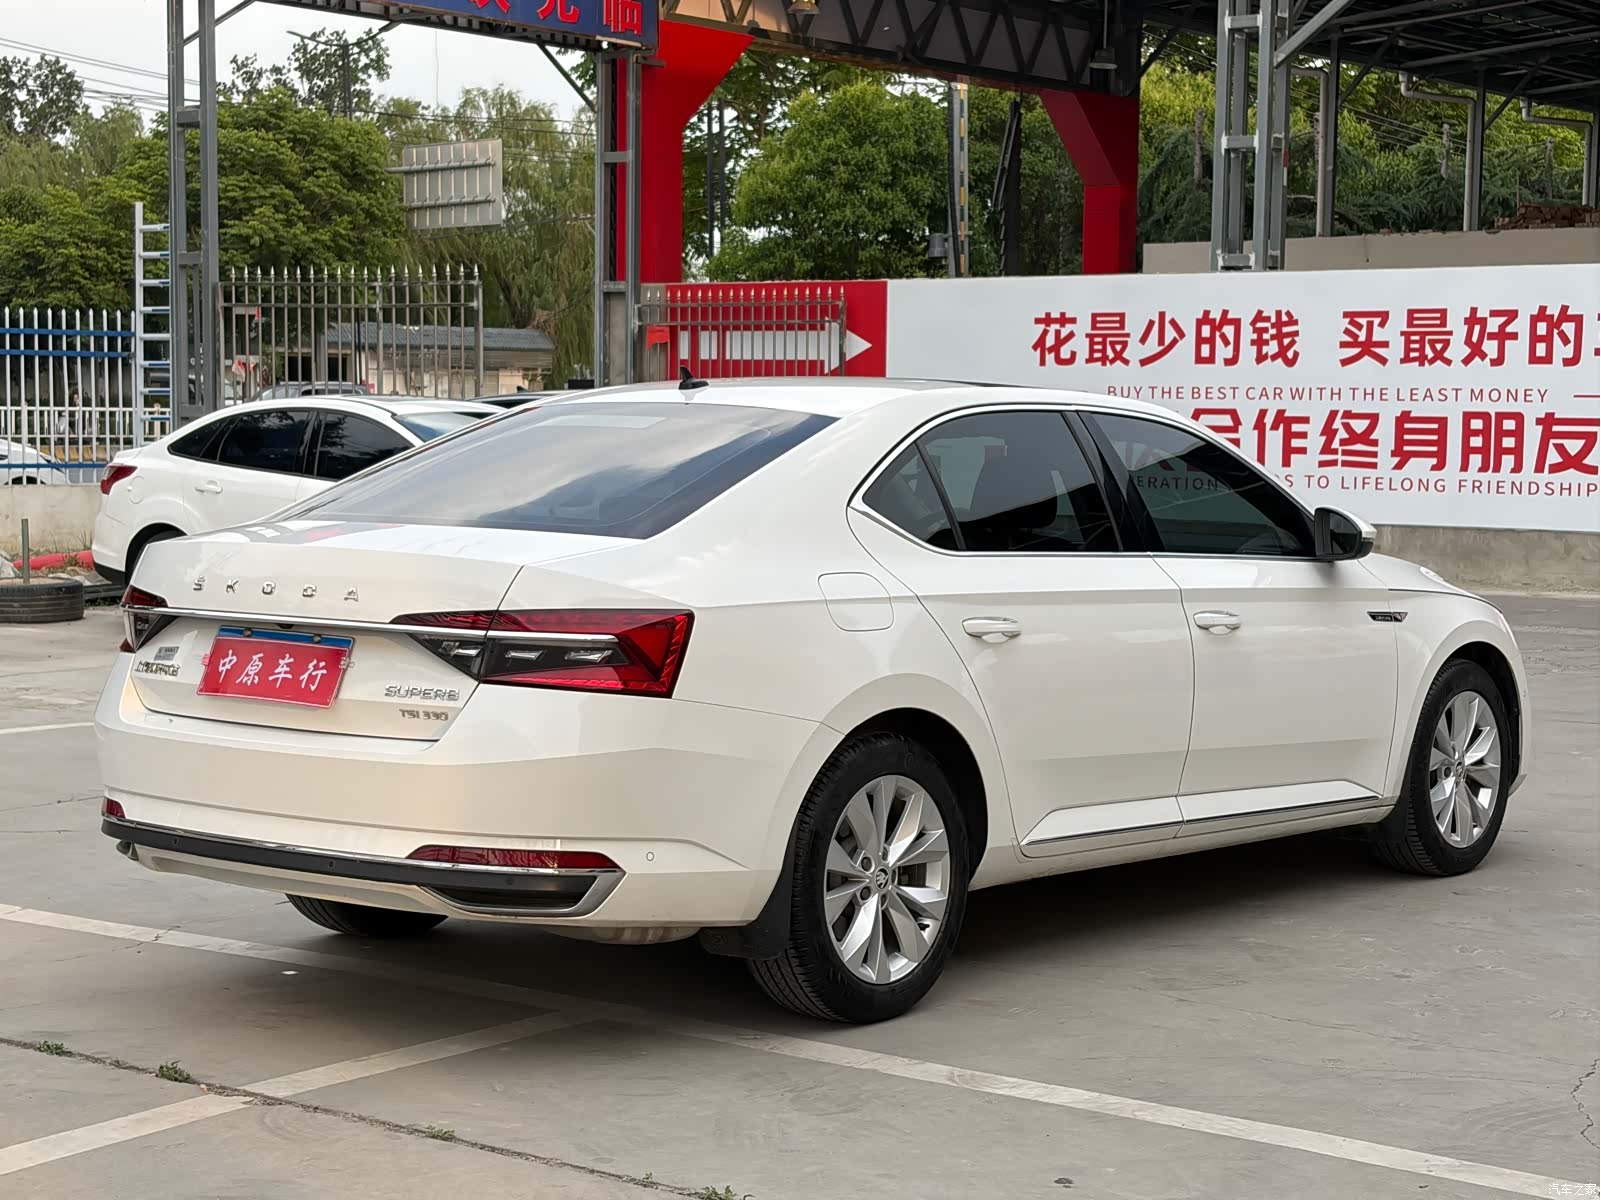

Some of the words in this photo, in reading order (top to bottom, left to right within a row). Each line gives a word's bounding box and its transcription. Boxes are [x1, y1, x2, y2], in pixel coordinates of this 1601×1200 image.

[1031, 309, 1300, 367] 花最少的钱
[1339, 304, 1600, 367] 买最好的
[1107, 385, 1143, 399] BUY
[1148, 386, 1185, 400] THE
[1191, 386, 1239, 400] BEST
[1245, 386, 1284, 401] CAR
[1289, 387, 1342, 401] WITH
[1349, 387, 1389, 402] THE
[1396, 387, 1463, 402] LEAST
[1470, 388, 1549, 403] MONEY
[1157, 407, 1600, 475] 合作终身朋友
[1304, 475, 1330, 489] TO
[1340, 476, 1446, 492] LIFELONG
[1458, 479, 1598, 497] FRIENDSHIP
[218, 649, 328, 691] 中原车行
[384, 685, 460, 701] SUPERB
[399, 709, 421, 719] TSI
[422, 710, 449, 721] 330
